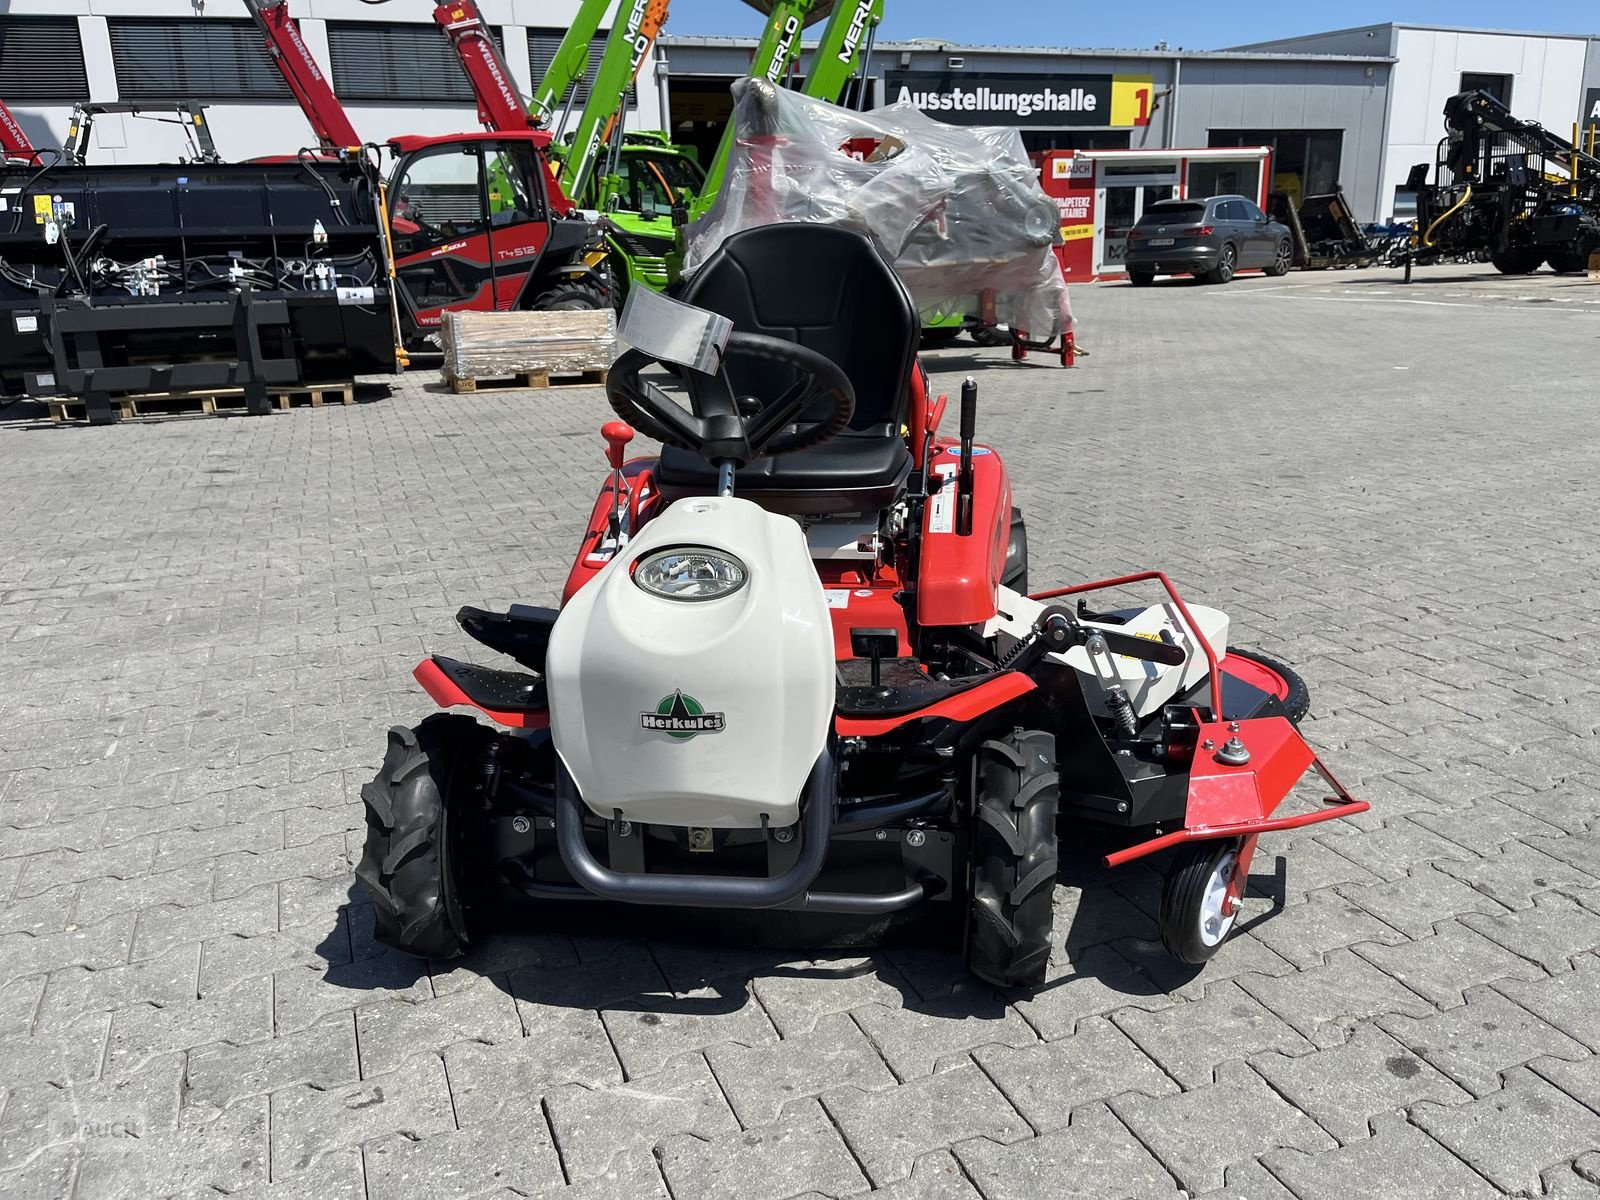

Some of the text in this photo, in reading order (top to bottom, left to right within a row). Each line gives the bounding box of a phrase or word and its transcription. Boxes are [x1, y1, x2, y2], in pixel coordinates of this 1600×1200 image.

[285, 21, 322, 81] WEIDEMANN
[477, 39, 518, 111] WEIDEMANN
[896, 86, 1151, 126] Ausstellungshalle 1
[1057, 163, 1090, 174] MAUCH
[498, 245, 536, 259] T4512
[642, 716, 723, 729] Herkules
